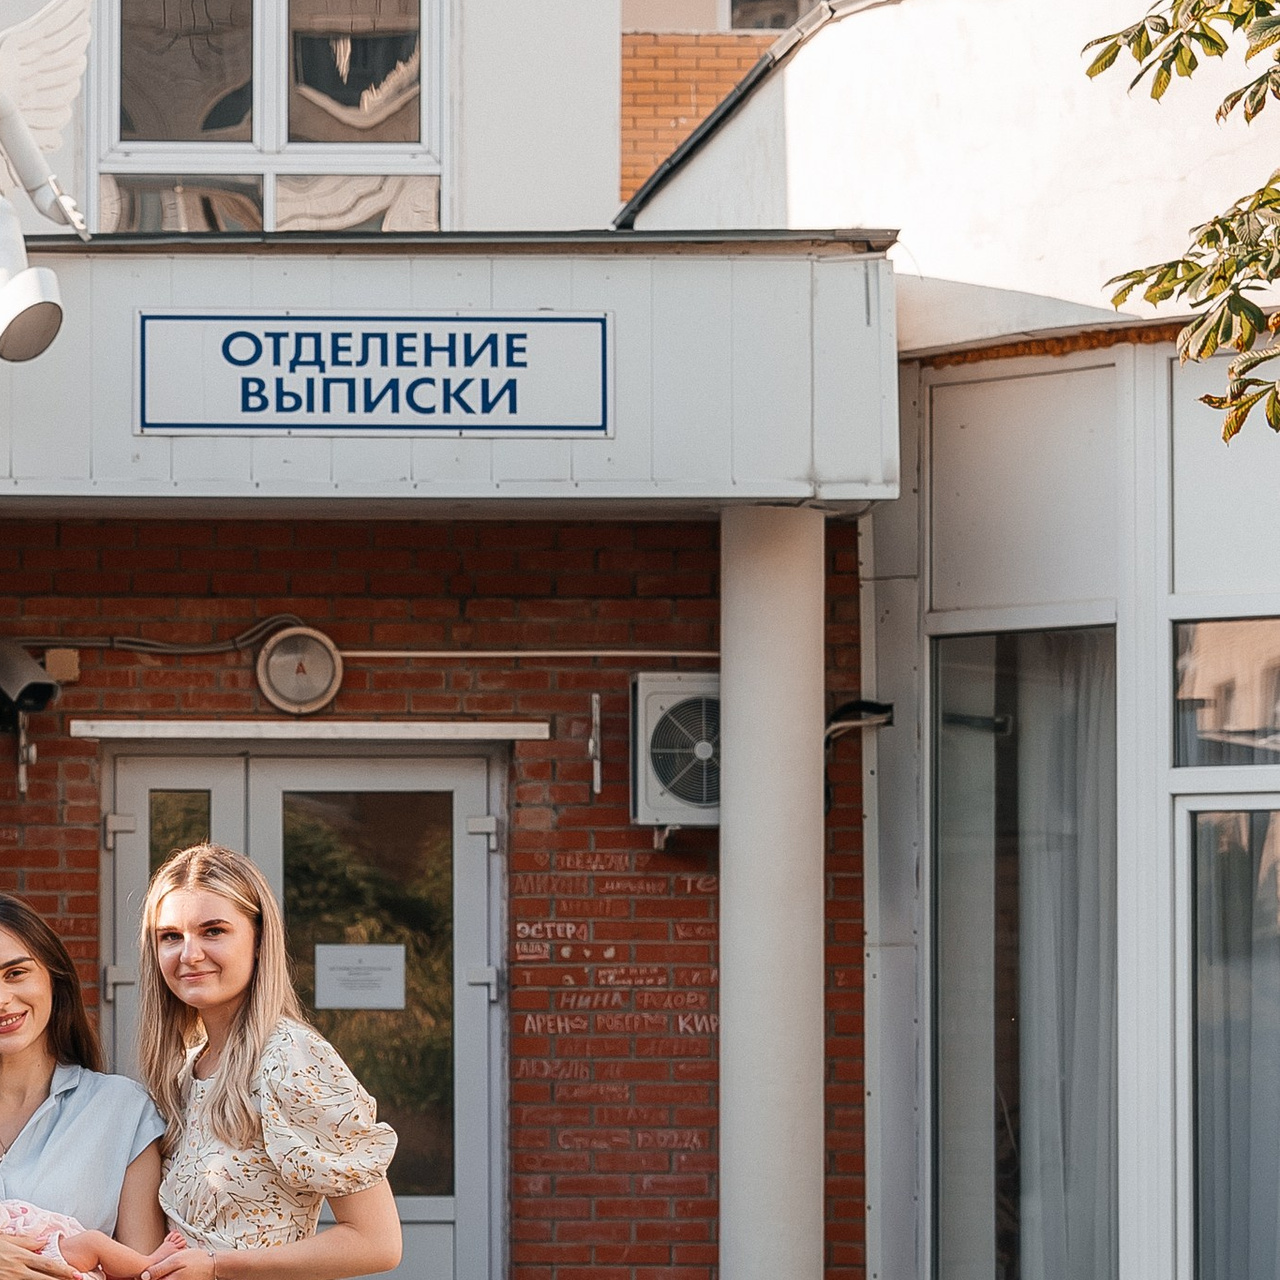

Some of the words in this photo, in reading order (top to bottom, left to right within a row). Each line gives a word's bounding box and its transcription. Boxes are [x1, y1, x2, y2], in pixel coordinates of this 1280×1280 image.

[221, 330, 528, 374] ОТДЕЛЕНИЕ
[241, 377, 517, 414] ВЫПИСКИ
[524, 1013, 570, 1035] АРЕН
